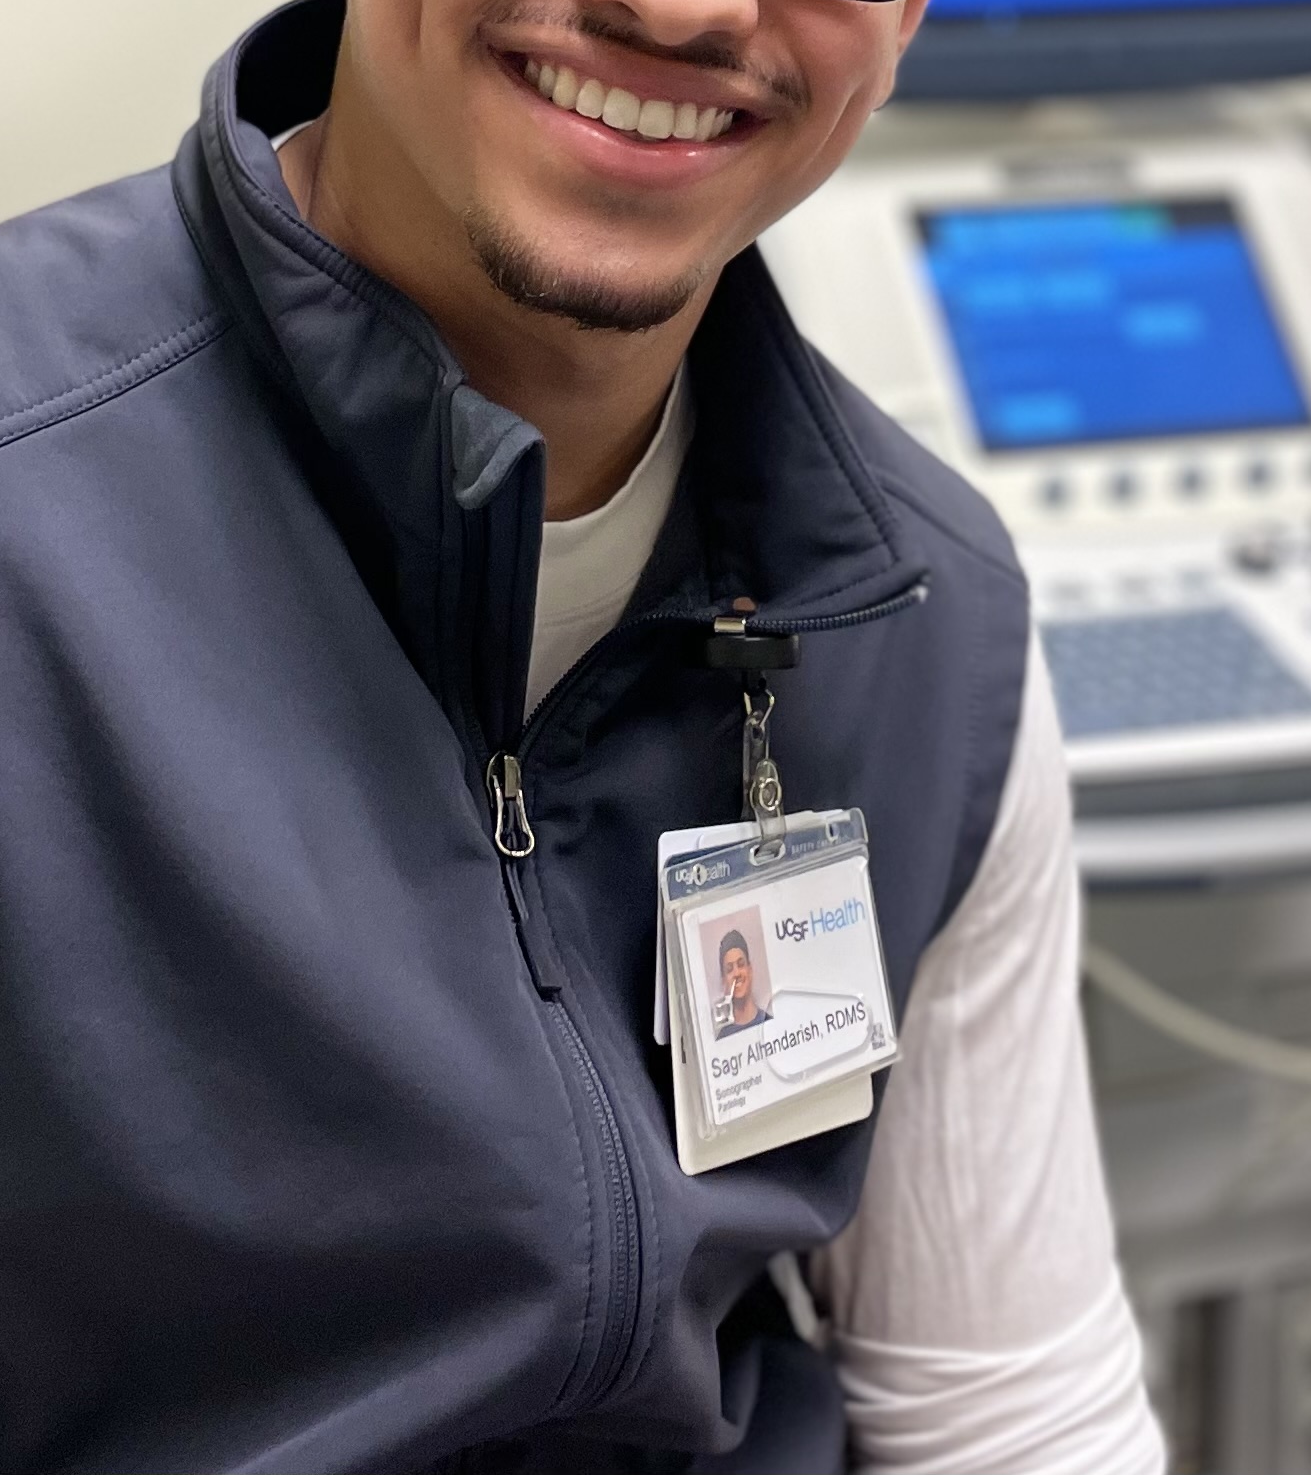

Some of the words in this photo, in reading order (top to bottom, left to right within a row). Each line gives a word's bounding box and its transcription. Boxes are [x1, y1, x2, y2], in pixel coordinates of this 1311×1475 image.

[775, 918, 808, 942] UCSF
[810, 897, 865, 937] Health
[711, 1052, 743, 1079] Sagr
[825, 1001, 867, 1034] RDMS
